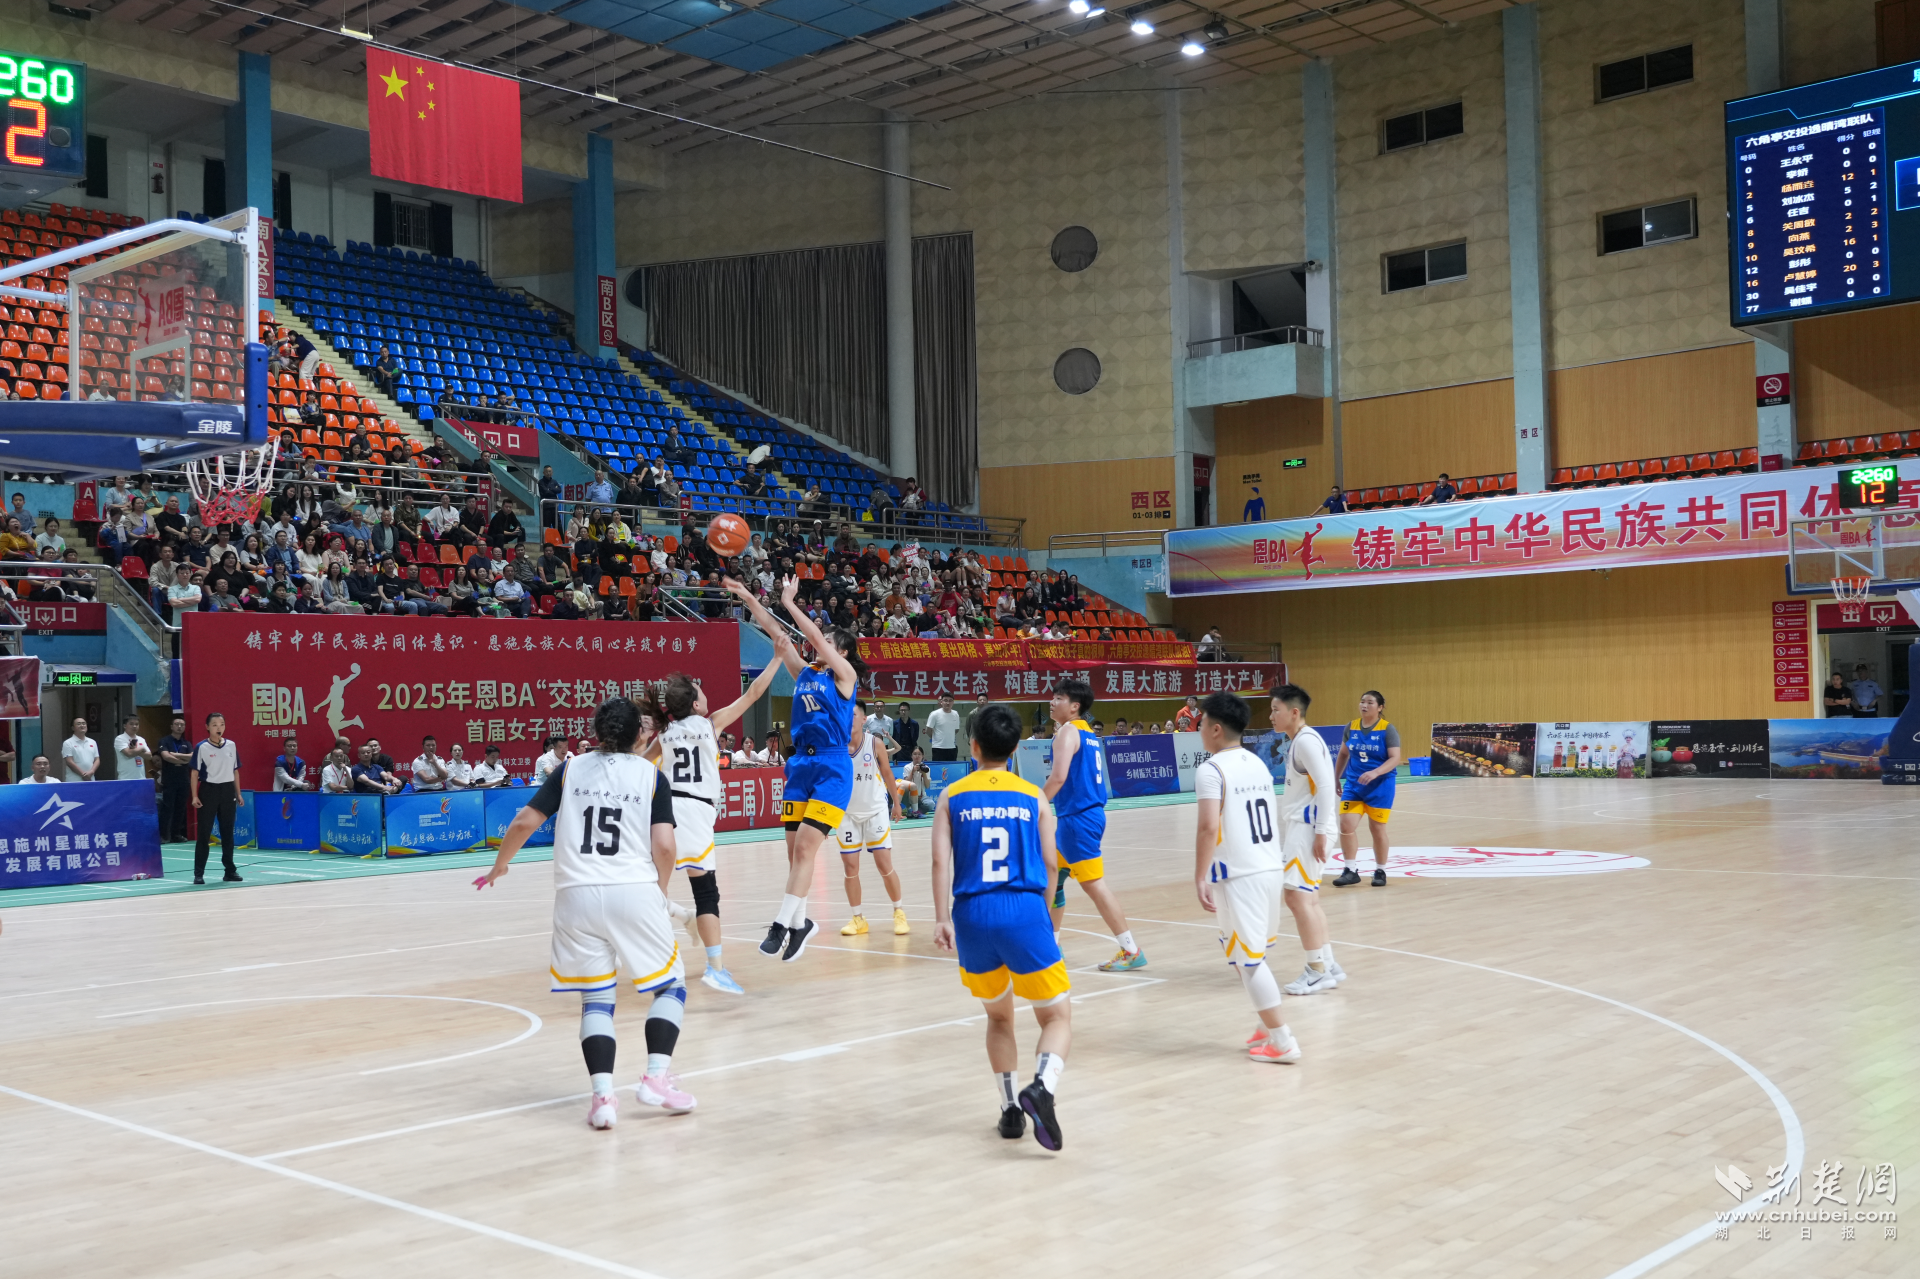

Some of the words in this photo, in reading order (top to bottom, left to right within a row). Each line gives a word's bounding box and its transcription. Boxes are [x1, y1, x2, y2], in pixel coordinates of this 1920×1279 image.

[0, 55, 74, 104] 260
[6, 98, 46, 166] 2
[1745, 113, 1874, 148] 六角亭交投逸晴湾联队
[1841, 172, 1854, 181] 12
[1747, 229, 1754, 237] 8
[1845, 225, 1852, 233] 2
[1843, 238, 1856, 246] 16
[1843, 264, 1857, 272] 20
[601, 279, 614, 328] 南B区
[1746, 292, 1759, 300] 30
[1746, 305, 1759, 313] 77
[198, 419, 233, 434] 金陵
[1521, 428, 1538, 438] 西区
[84, 487, 93, 499] A
[565, 482, 593, 501] 南B
[1861, 481, 1885, 504] 12
[1131, 491, 1171, 509] 西区
[1253, 539, 1289, 565] 恩BA
[1132, 558, 1152, 568] 南区B
[892, 671, 988, 695] 立足大生态
[1105, 670, 1182, 693] 发展大旅游
[1195, 670, 1264, 692] 打造大产业
[252, 683, 307, 726] 恩BA
[801, 694, 821, 713] 10
[264, 729, 296, 738] 中国·恩施
[673, 746, 702, 783] 21
[1359, 751, 1368, 763] 5
[1126, 765, 1174, 780] 乡村振兴主办行
[573, 788, 641, 804] 恩施州中心医院
[1343, 802, 1350, 810] 5
[959, 807, 1031, 822] 六角亭办事处
[1246, 798, 1273, 844] 10
[580, 806, 622, 856] 15
[845, 832, 853, 843] 2
[6, 851, 121, 873] 发展有限公司
[982, 827, 1009, 882] 2
